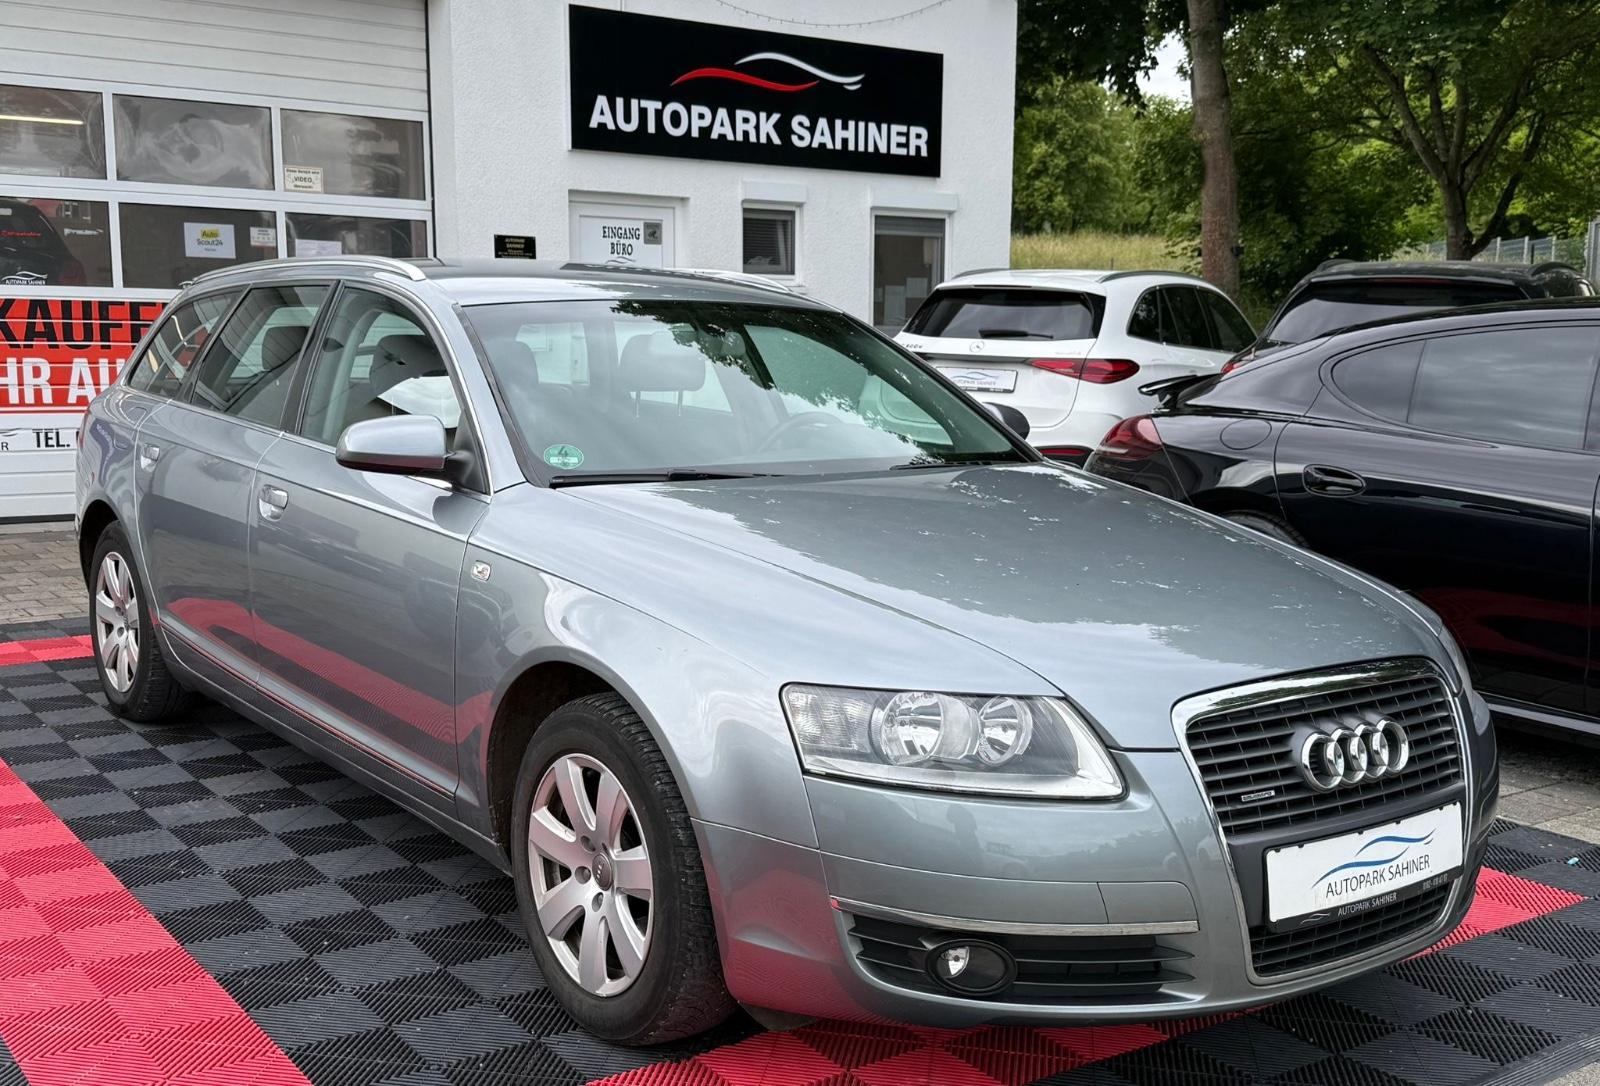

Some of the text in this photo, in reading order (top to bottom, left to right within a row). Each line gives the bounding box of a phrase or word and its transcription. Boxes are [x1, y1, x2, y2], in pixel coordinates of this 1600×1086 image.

[589, 95, 929, 157] AUTOPARK SAHINER
[202, 229, 218, 237] Auto
[602, 226, 640, 240] EINGANG
[197, 238, 223, 246] Scout24
[610, 240, 633, 255] BÜRO
[32, 428, 71, 448] TEL.
[558, 445, 569, 458] 4
[1326, 868, 1386, 899] AUTOPARK
[1388, 854, 1430, 881] SAHINER
[1337, 892, 1397, 917] AUTOPARK SAHINER
